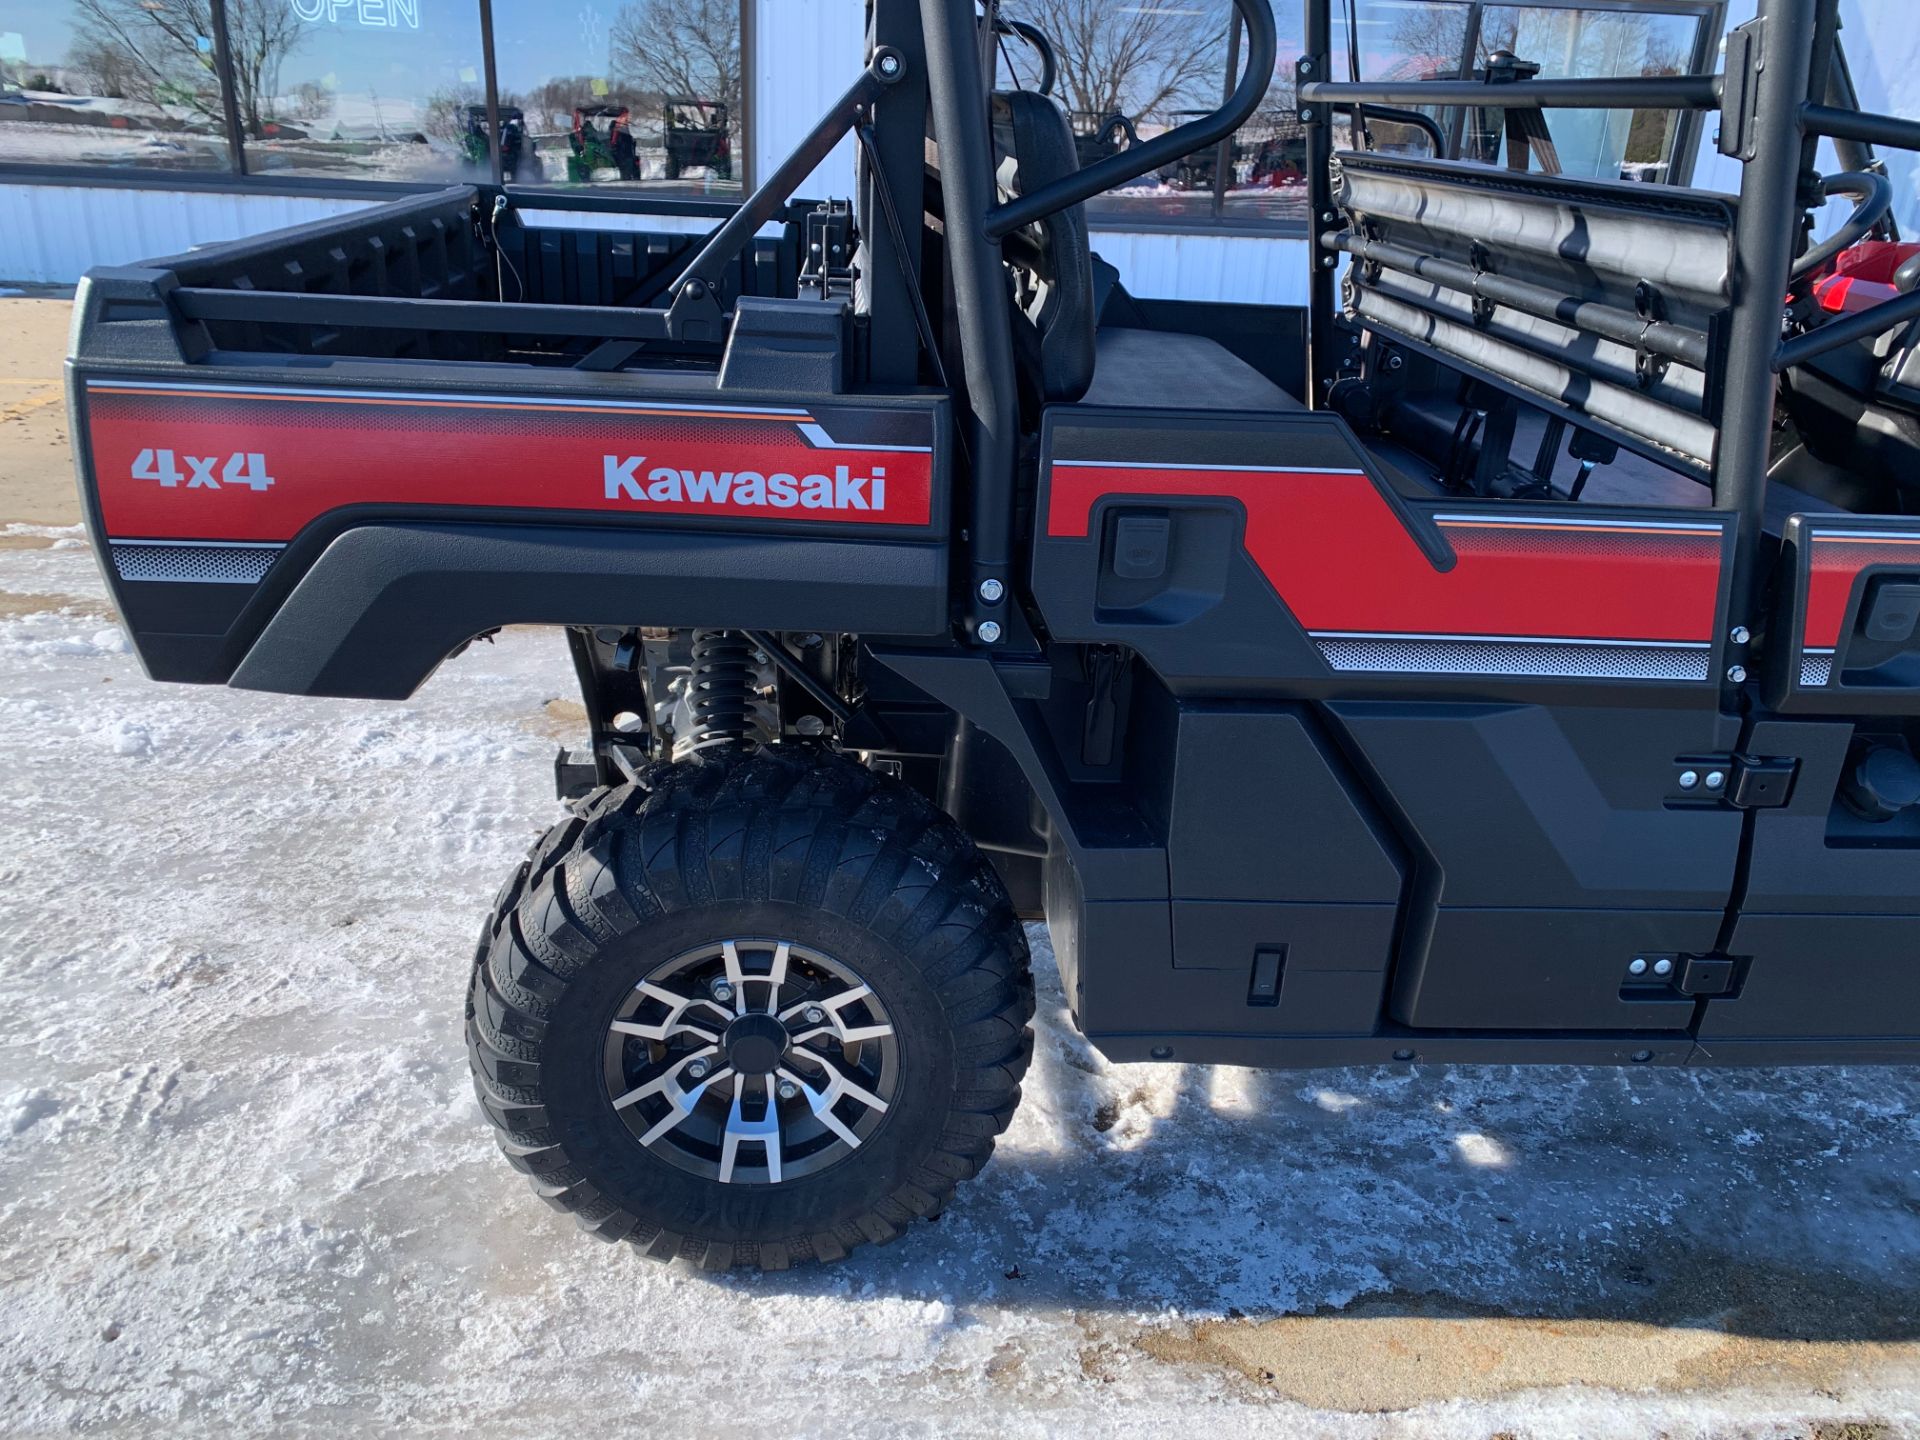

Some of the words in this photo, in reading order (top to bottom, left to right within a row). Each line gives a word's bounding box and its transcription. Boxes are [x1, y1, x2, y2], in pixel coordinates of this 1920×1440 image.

[291, 0, 419, 29] OPEN
[131, 448, 276, 491] 4x4
[603, 454, 886, 511] Kawasaki
